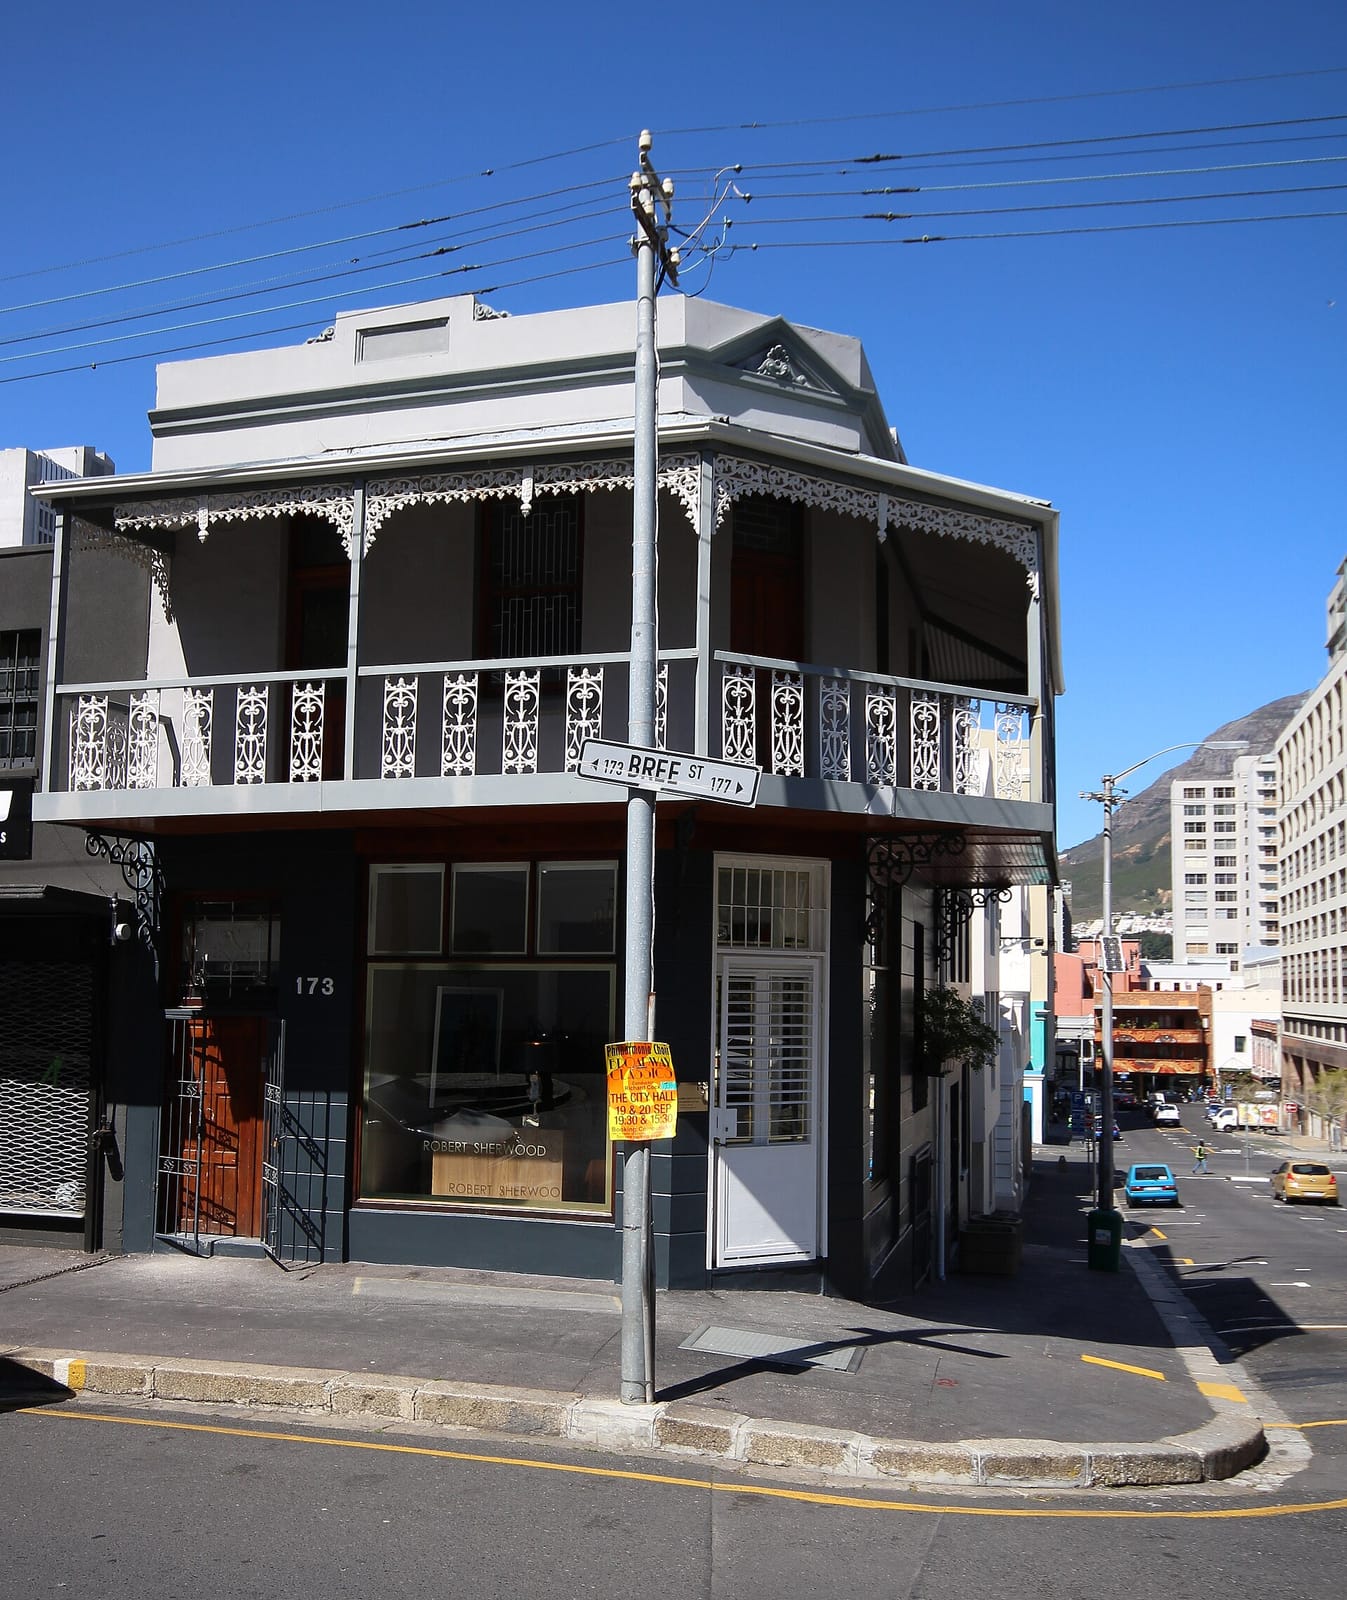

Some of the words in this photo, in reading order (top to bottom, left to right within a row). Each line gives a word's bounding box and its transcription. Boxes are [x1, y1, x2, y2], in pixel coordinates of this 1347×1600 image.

[604, 759, 624, 776] 173
[628, 754, 682, 785] BREE
[688, 764, 704, 780] ST
[711, 777, 732, 793] 177
[296, 976, 334, 995] 173
[610, 1093, 628, 1103] THE
[630, 1091, 650, 1103] CITY
[652, 1091, 676, 1101] HALL
[616, 1105, 626, 1115] 19
[629, 1105, 636, 1115] &
[639, 1104, 651, 1114] 20
[654, 1103, 672, 1114] SEP
[615, 1115, 638, 1126] 19:30
[640, 1114, 647, 1125] &
[651, 1113, 673, 1124] 15:30
[423, 1140, 468, 1153] ROBERT
[473, 1141, 547, 1157] SHERWOOD
[448, 1182, 493, 1195] ROBERT
[499, 1184, 561, 1198] SHERWOO
